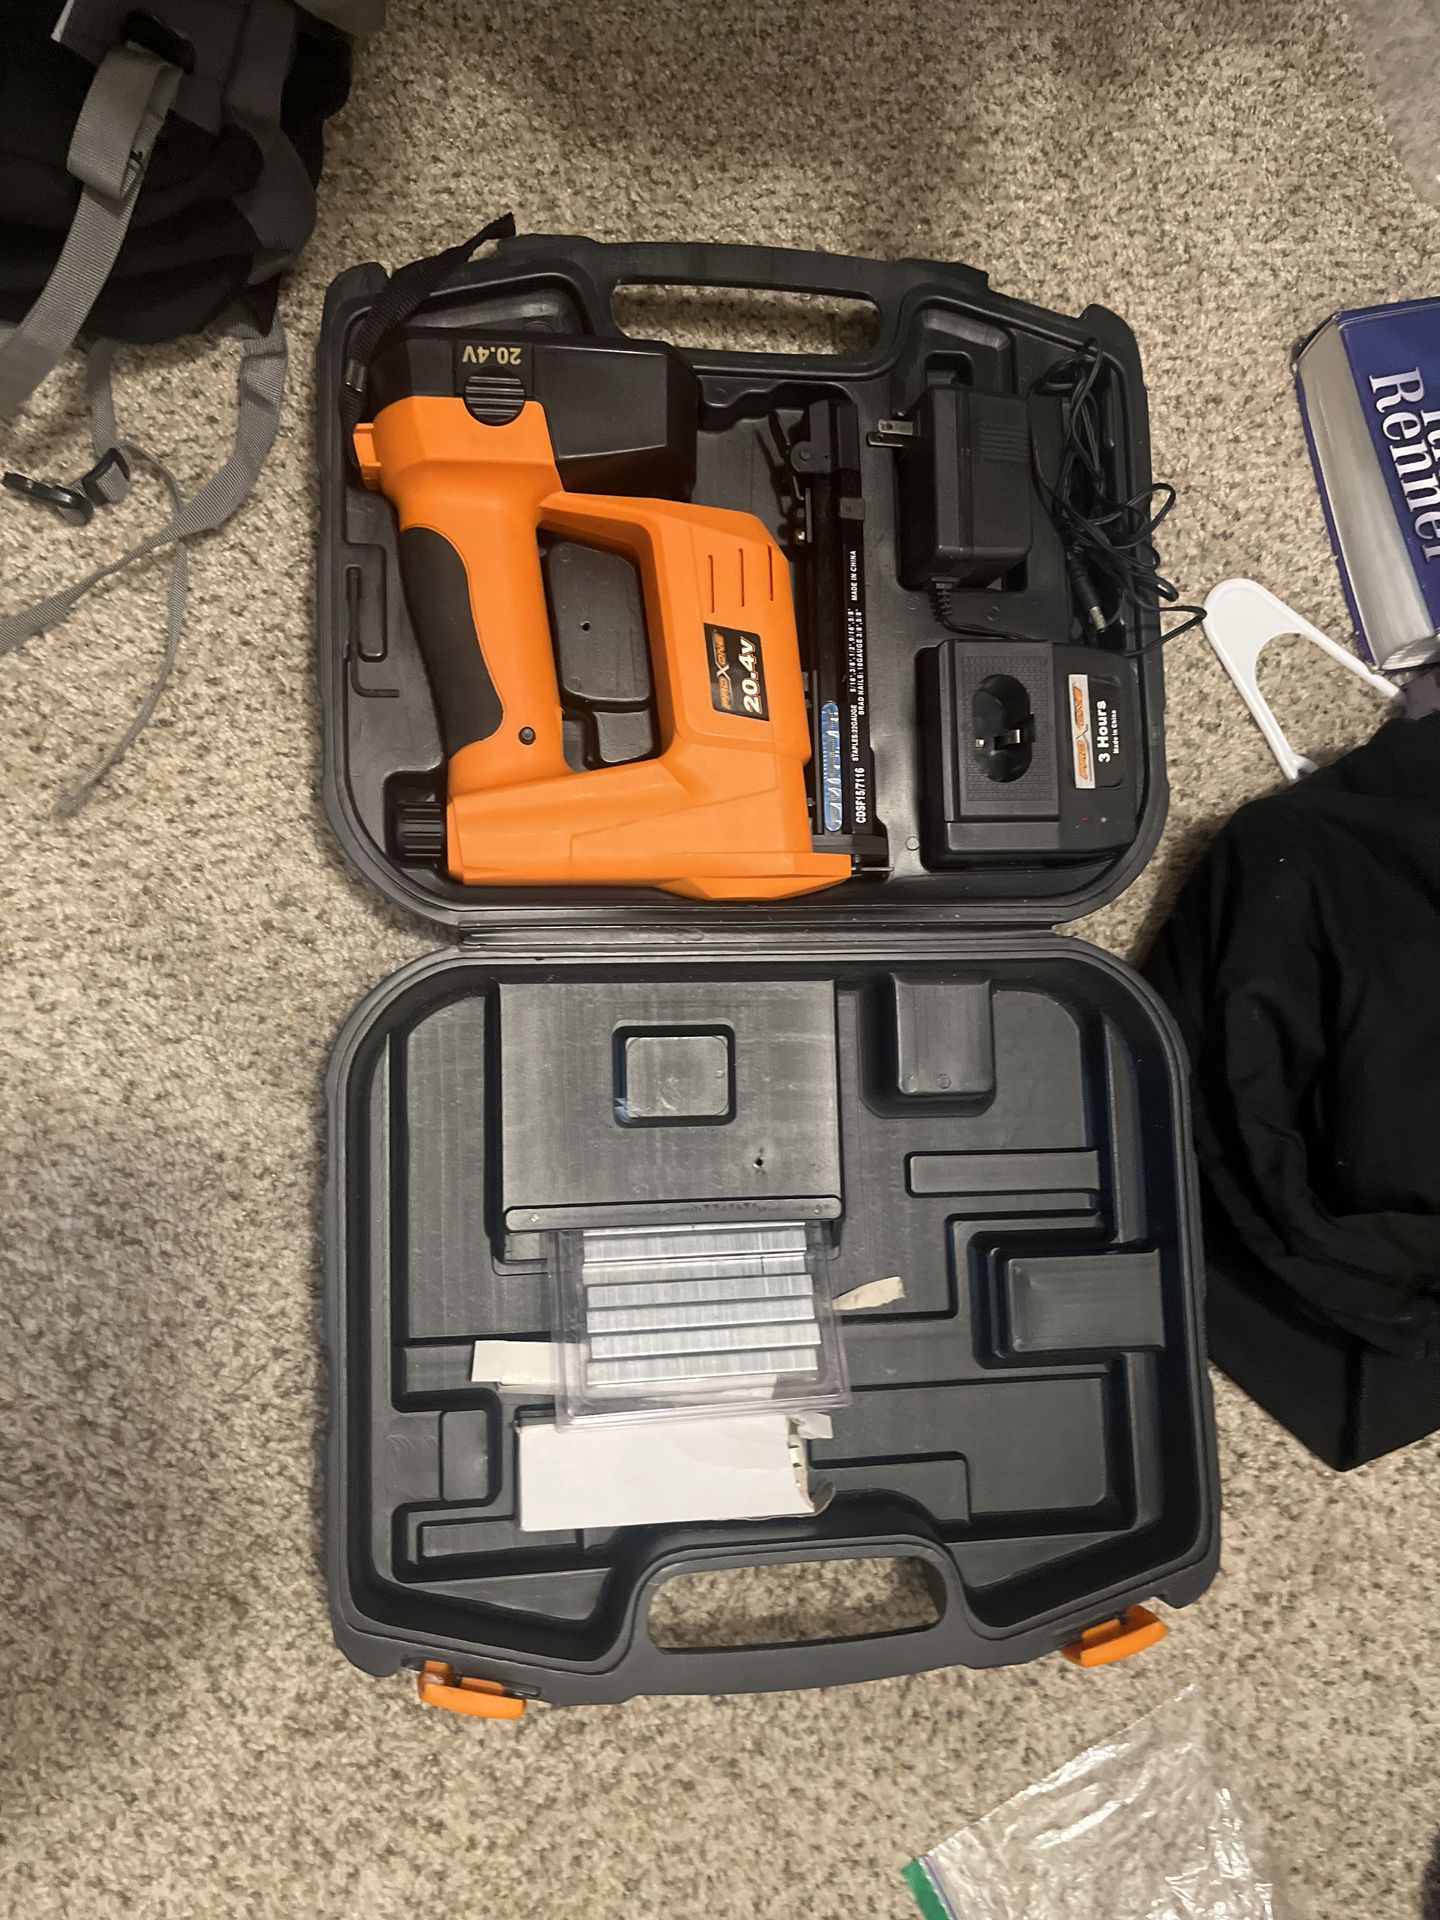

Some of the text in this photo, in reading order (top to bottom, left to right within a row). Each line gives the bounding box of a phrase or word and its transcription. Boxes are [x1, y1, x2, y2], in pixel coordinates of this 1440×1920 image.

[462, 345, 521, 365] 20.4V
[849, 550, 858, 601] MADE IN CHINA
[856, 671, 865, 696] NAILS:
[857, 696, 865, 716] BRAD
[1097, 700, 1111, 763] 3 Hours
[855, 767, 867, 824] CDSF15/7116
